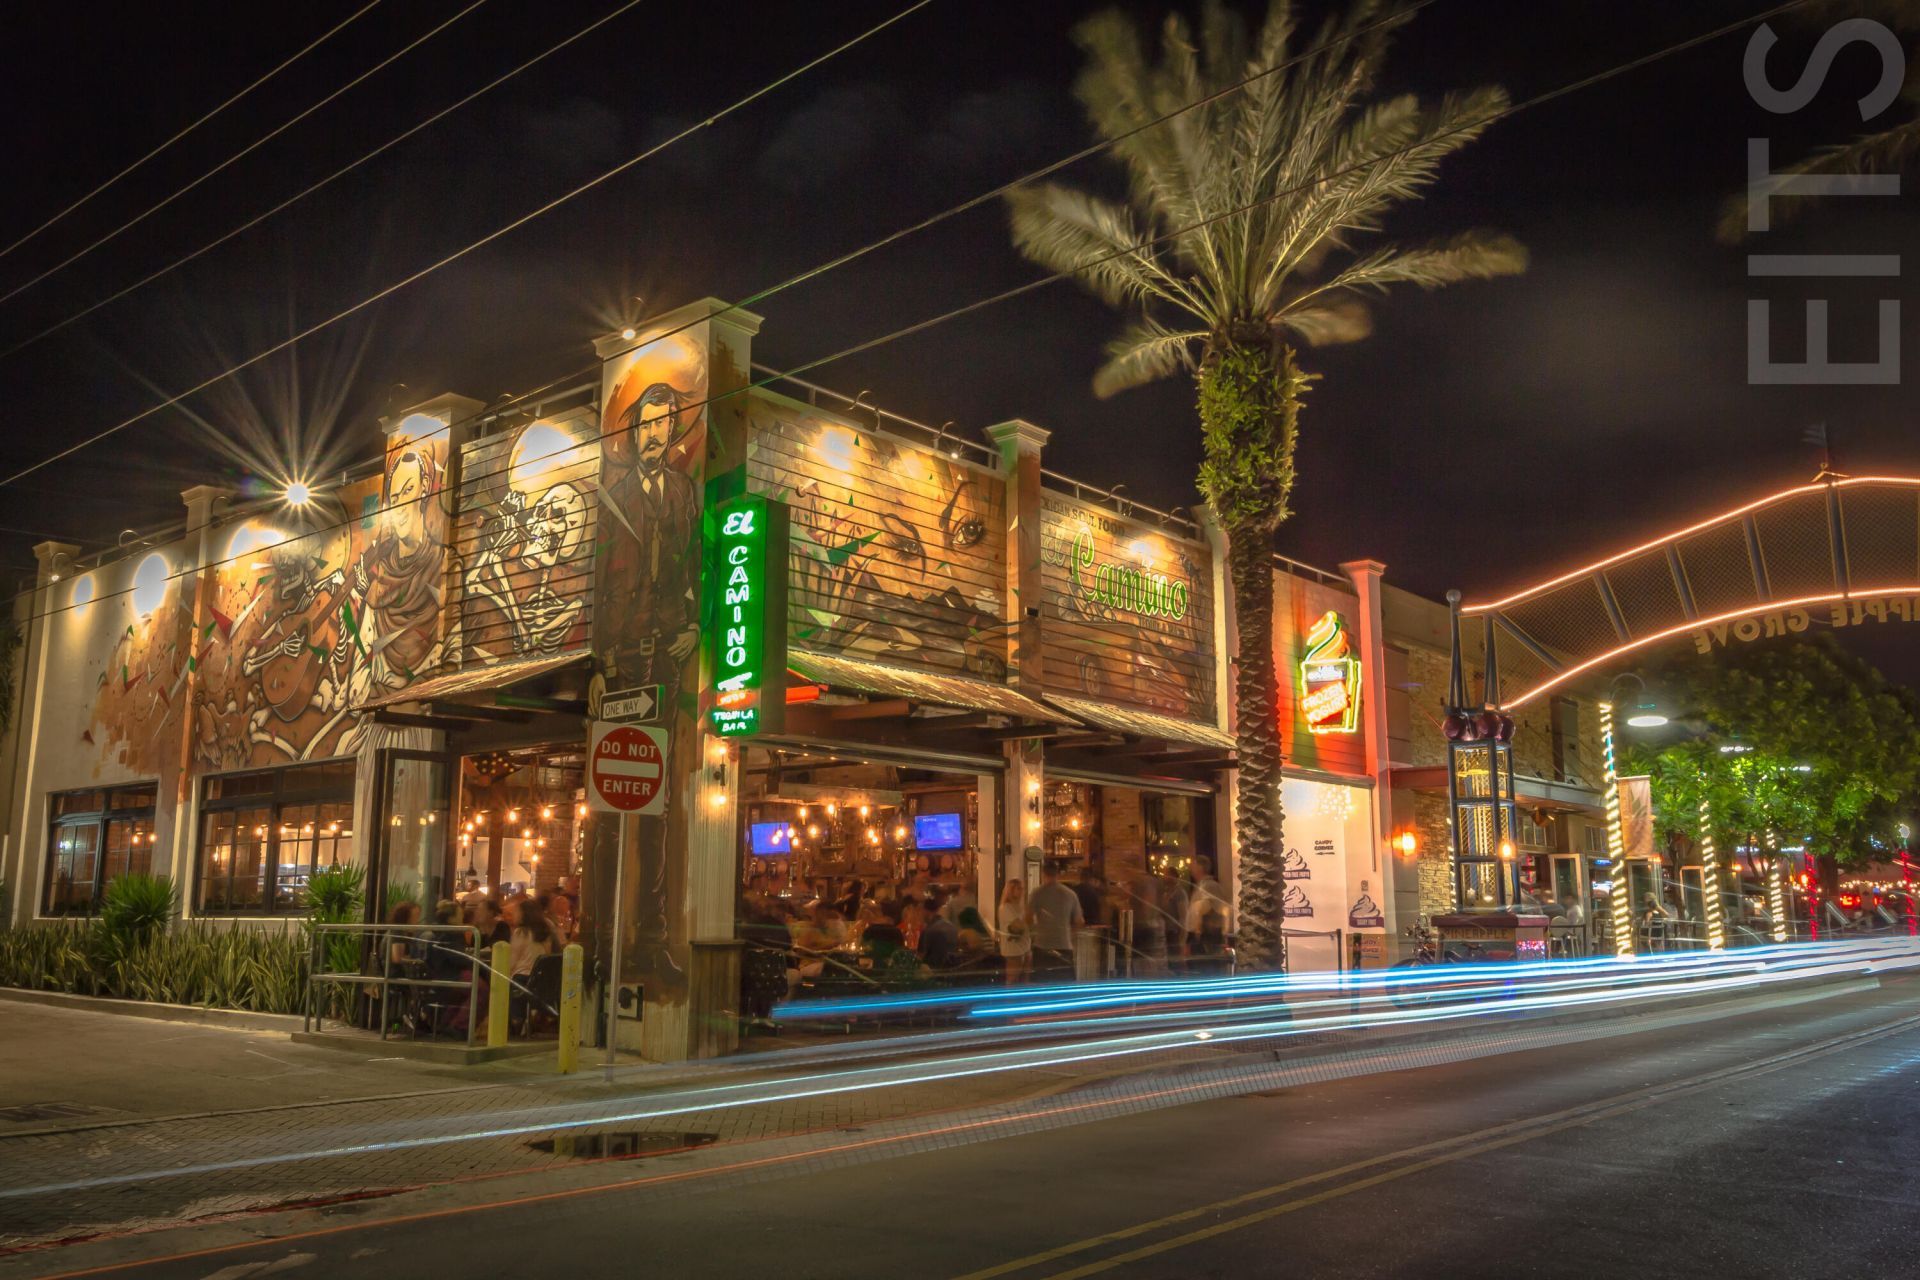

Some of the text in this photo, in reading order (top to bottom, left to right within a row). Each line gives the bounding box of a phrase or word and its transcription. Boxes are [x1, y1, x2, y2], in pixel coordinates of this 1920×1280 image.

[723, 510, 754, 535] El
[1098, 516, 1126, 537] FOOD
[1071, 526, 1187, 621] Camino
[725, 546, 750, 667] CAMINO
[605, 698, 639, 717] ONE WAY
[722, 721, 747, 732] BAR
[601, 741, 656, 758] DO NOT
[603, 779, 651, 796] ENTER
